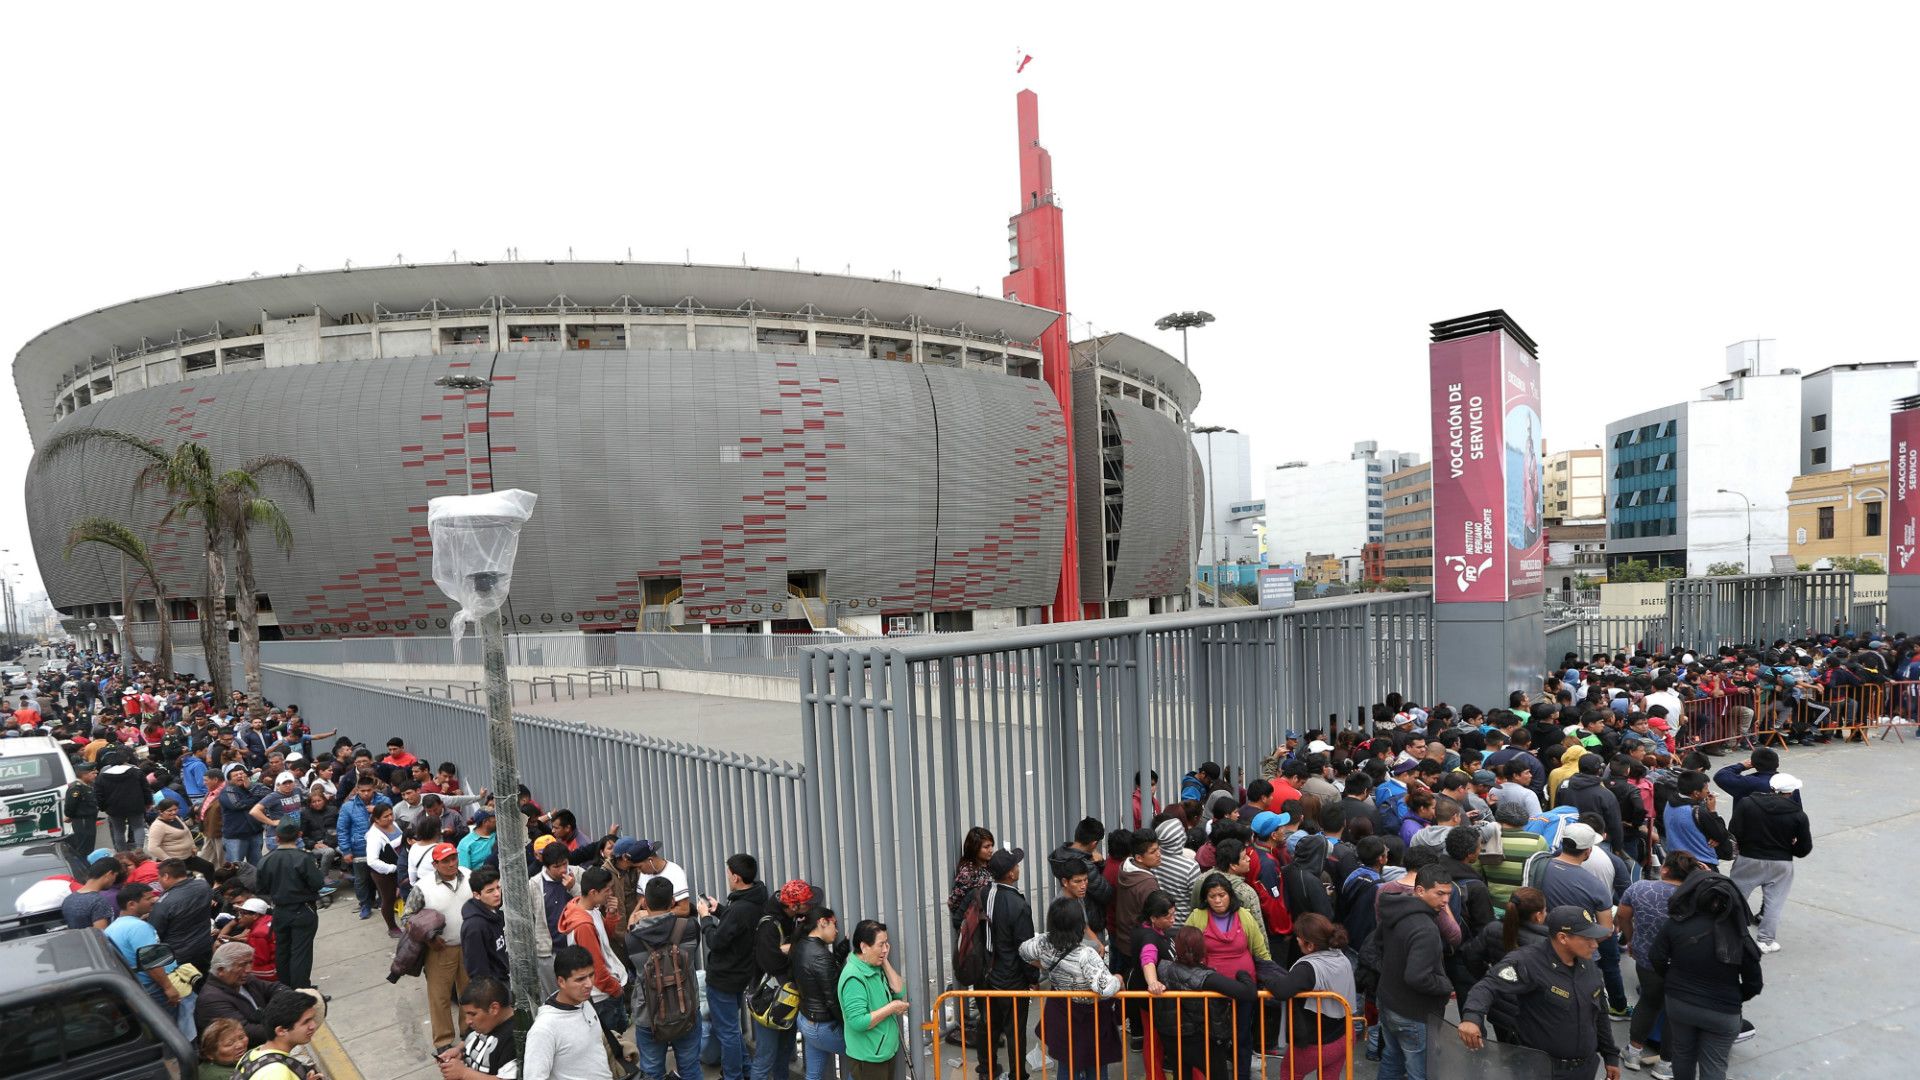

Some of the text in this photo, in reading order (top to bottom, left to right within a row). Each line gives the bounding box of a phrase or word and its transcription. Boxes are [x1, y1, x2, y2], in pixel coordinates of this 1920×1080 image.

[1447, 383, 1464, 478] VOCACIÓN DE
[1470, 396, 1483, 460] SERVICIO
[1898, 440, 1907, 501] VOCACIÓN DE
[1909, 449, 1917, 490] SERVICIO
[1465, 520, 1474, 555] INSTITUTO
[1474, 522, 1483, 554] PERUANO
[1483, 508, 1493, 554] DEL DEPORTE
[1465, 565, 1477, 582] IPD
